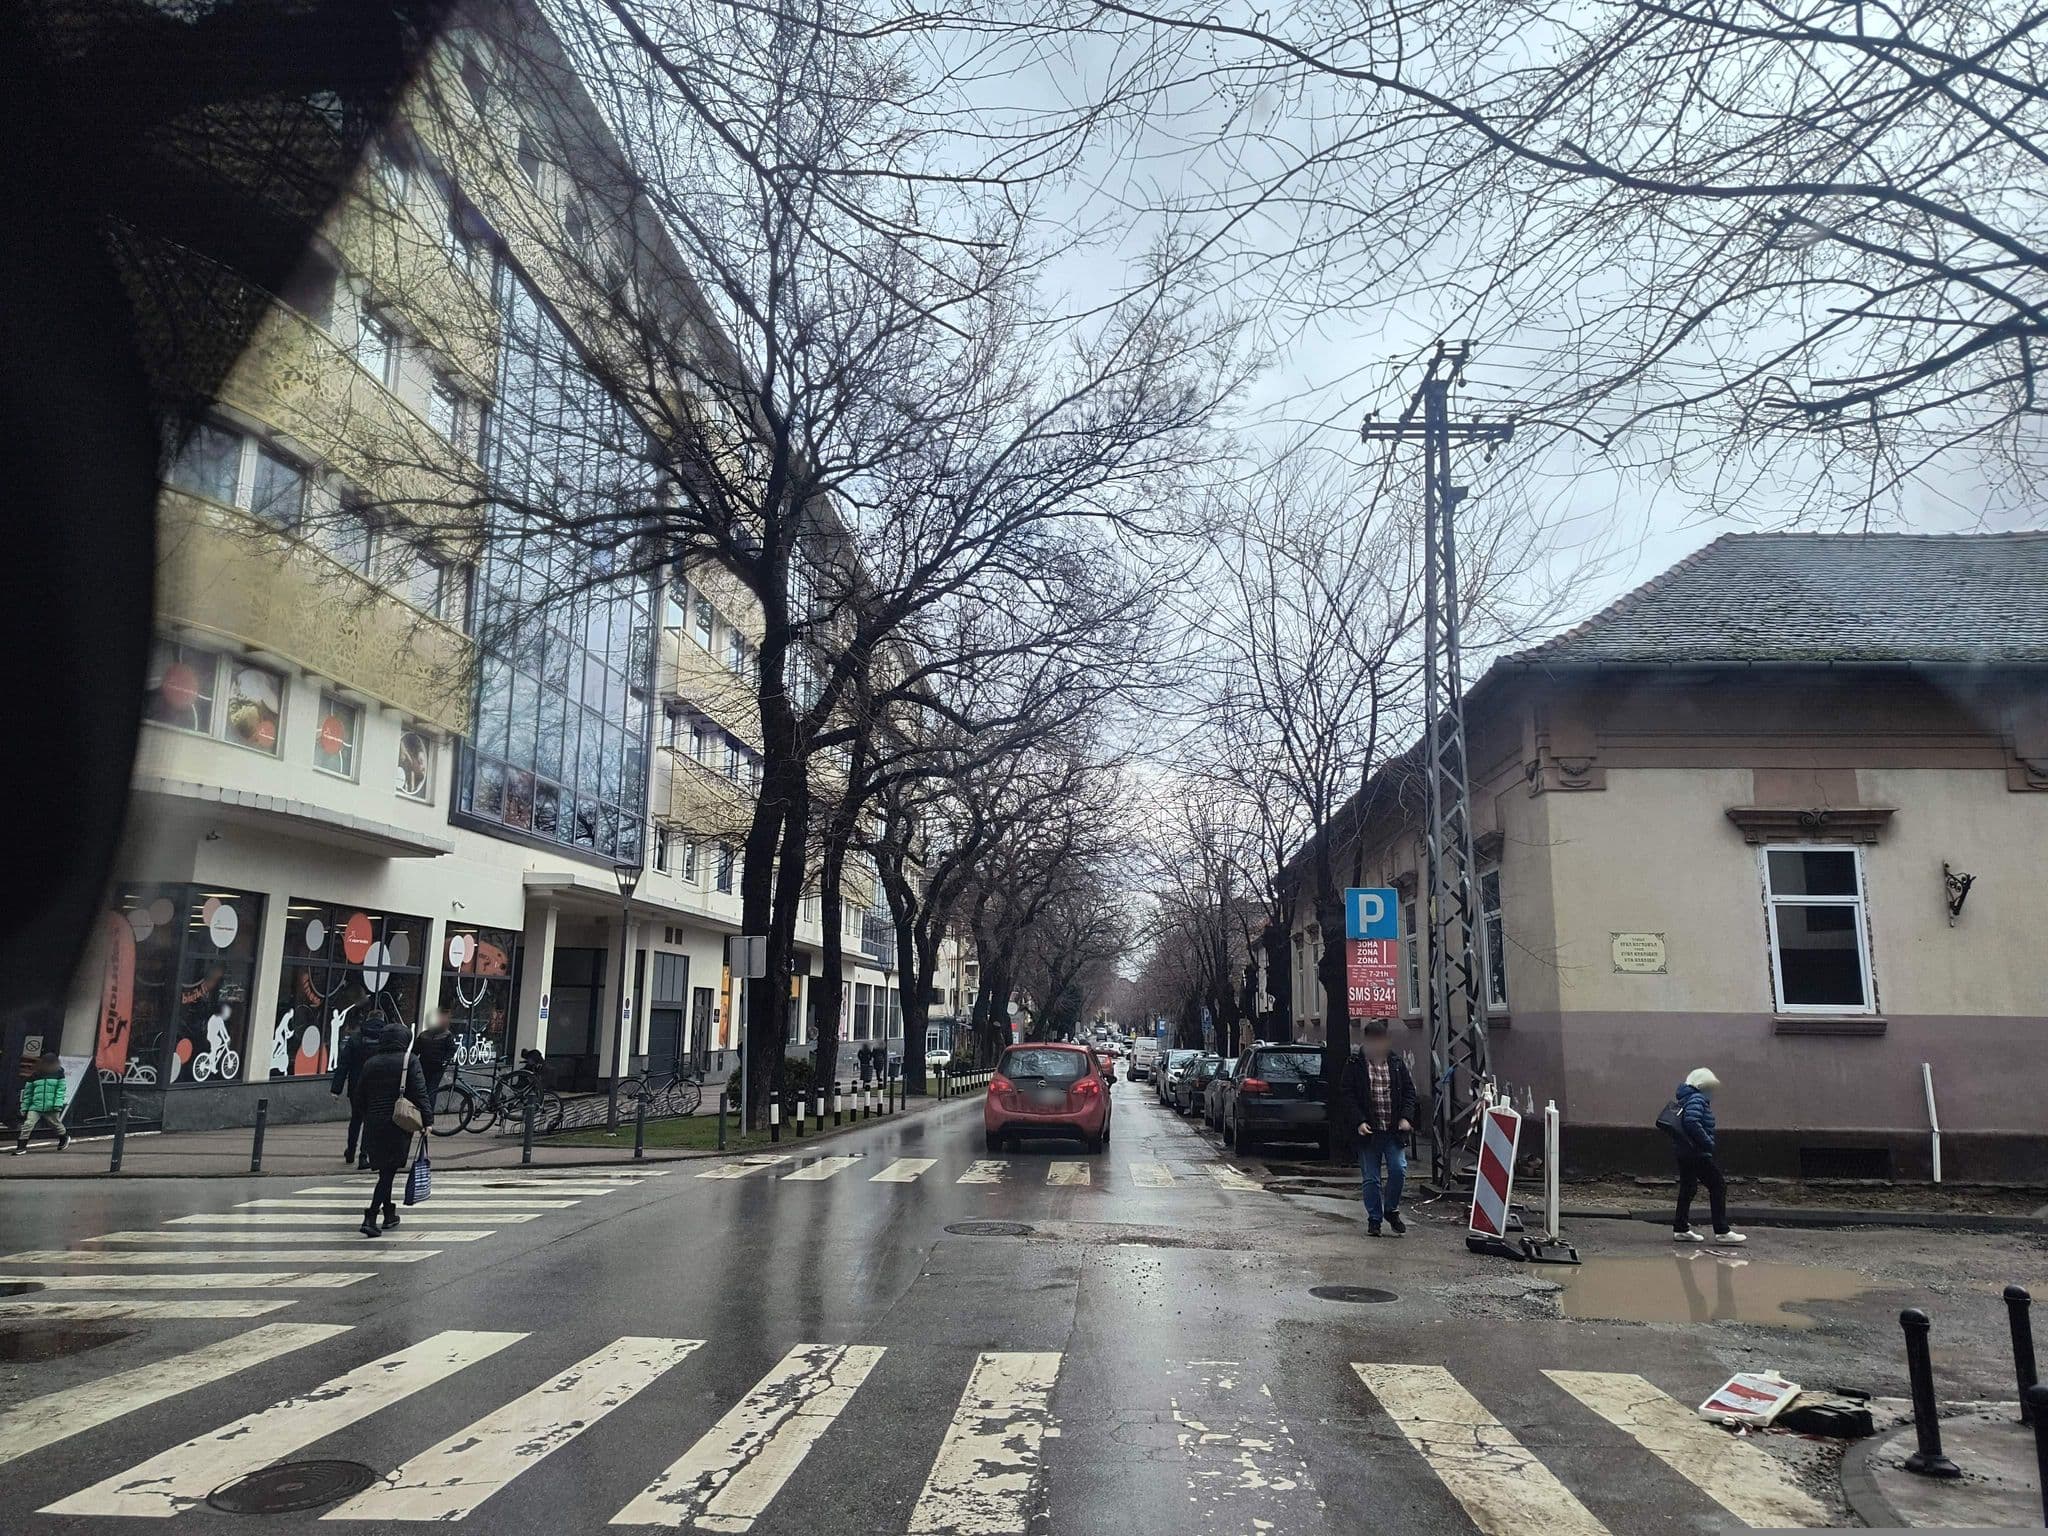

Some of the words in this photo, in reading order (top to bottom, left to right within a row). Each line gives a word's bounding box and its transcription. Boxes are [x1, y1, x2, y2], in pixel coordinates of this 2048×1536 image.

[1358, 893, 1385, 933] P
[1349, 987, 1371, 1001] SMS
[1373, 987, 1396, 1002] 9241
